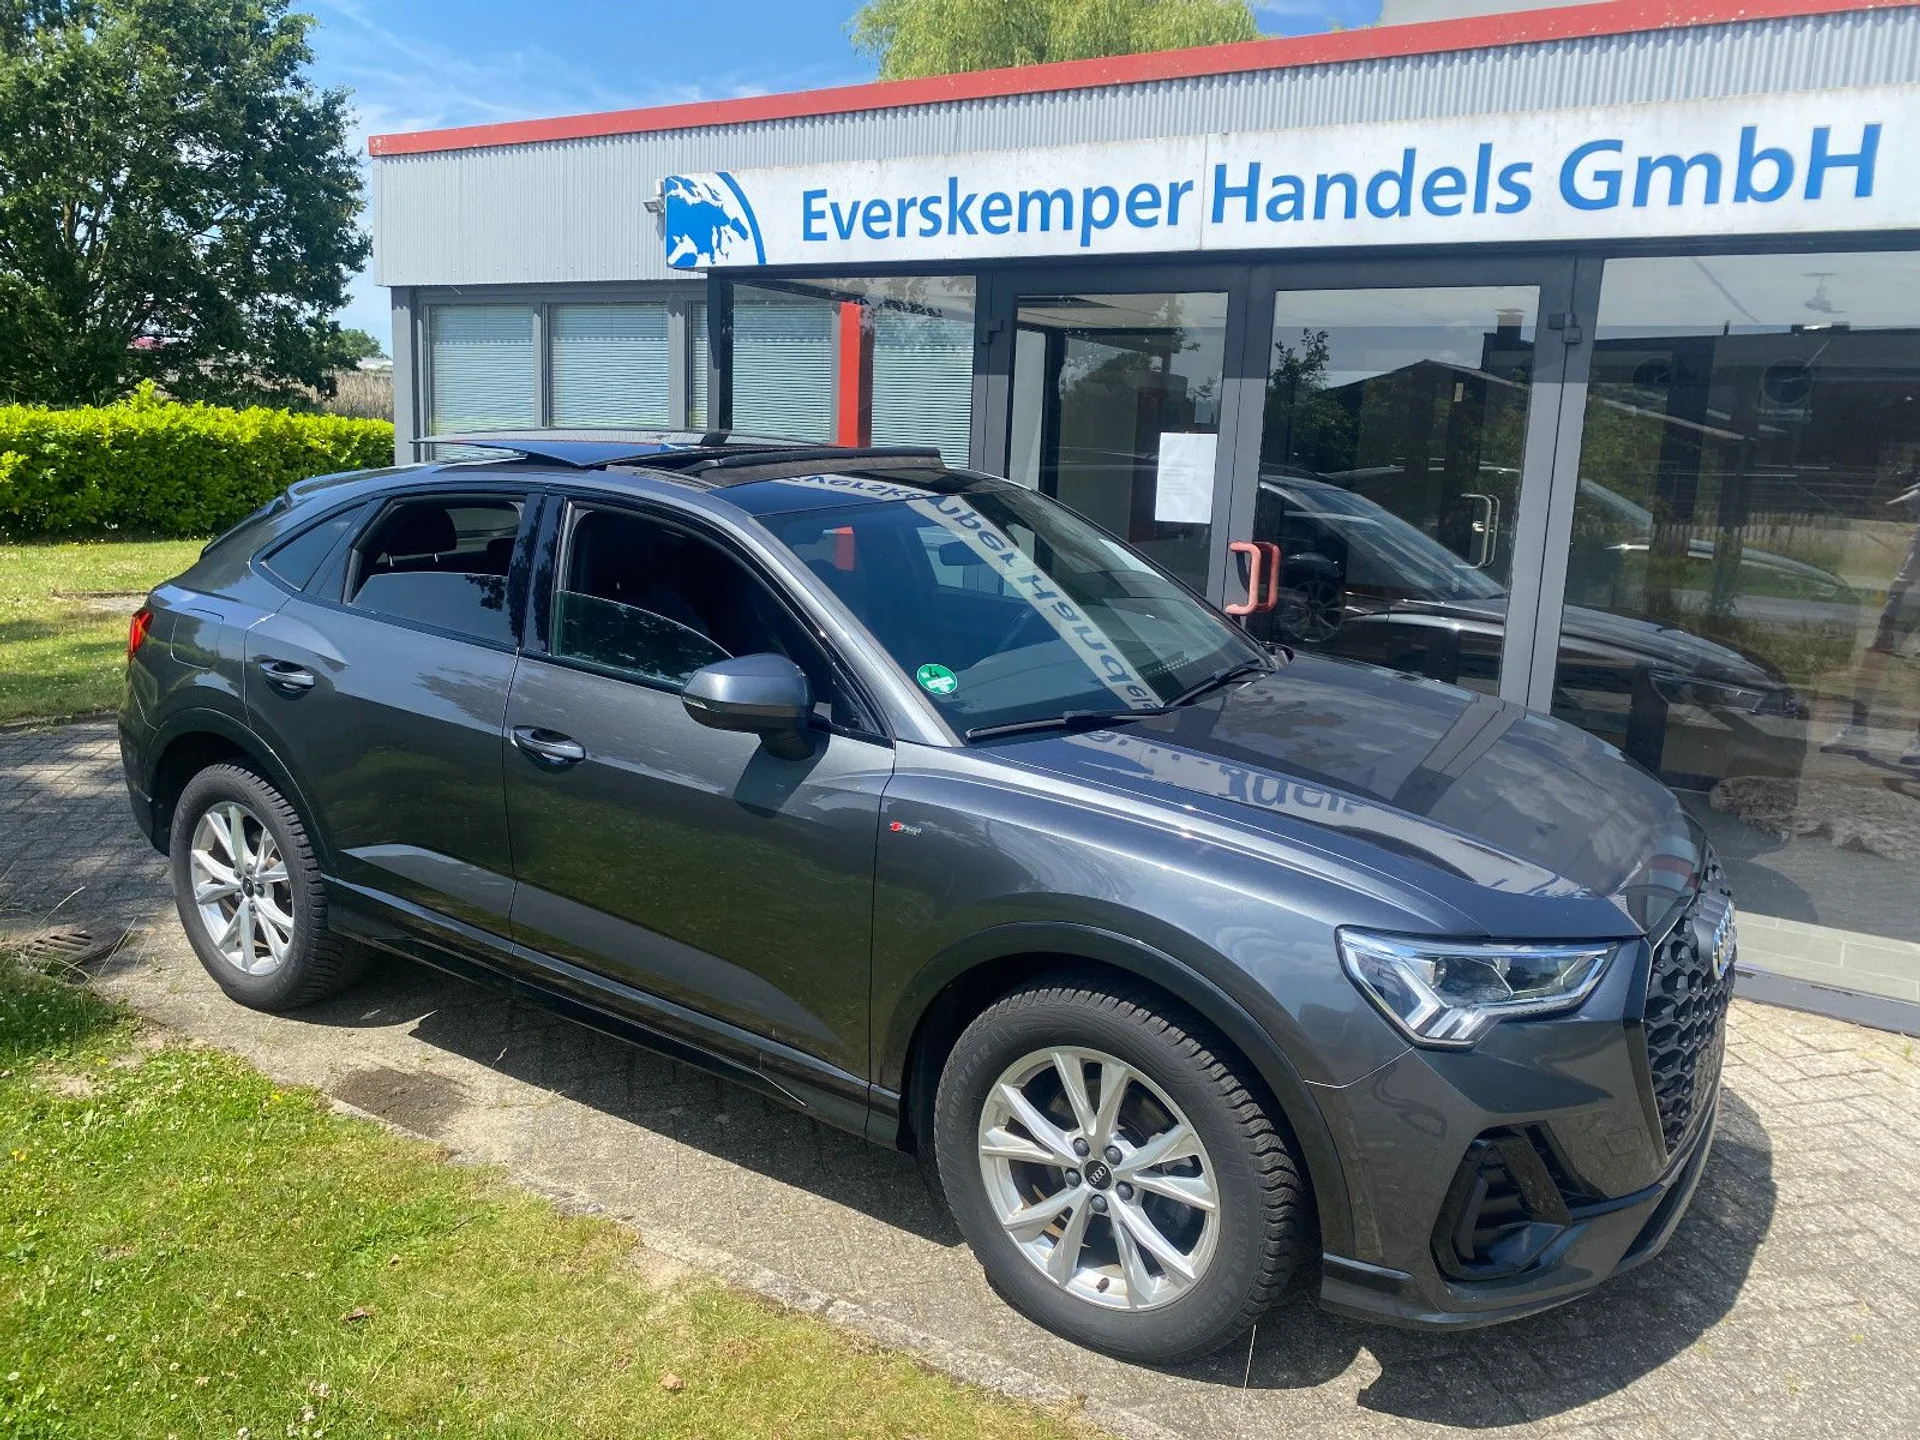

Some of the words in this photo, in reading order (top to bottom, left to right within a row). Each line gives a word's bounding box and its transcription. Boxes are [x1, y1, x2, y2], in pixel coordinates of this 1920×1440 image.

[802, 176, 1194, 248] Everskemper
[1211, 142, 1533, 225] Handels
[1559, 123, 1882, 212] GmbH
